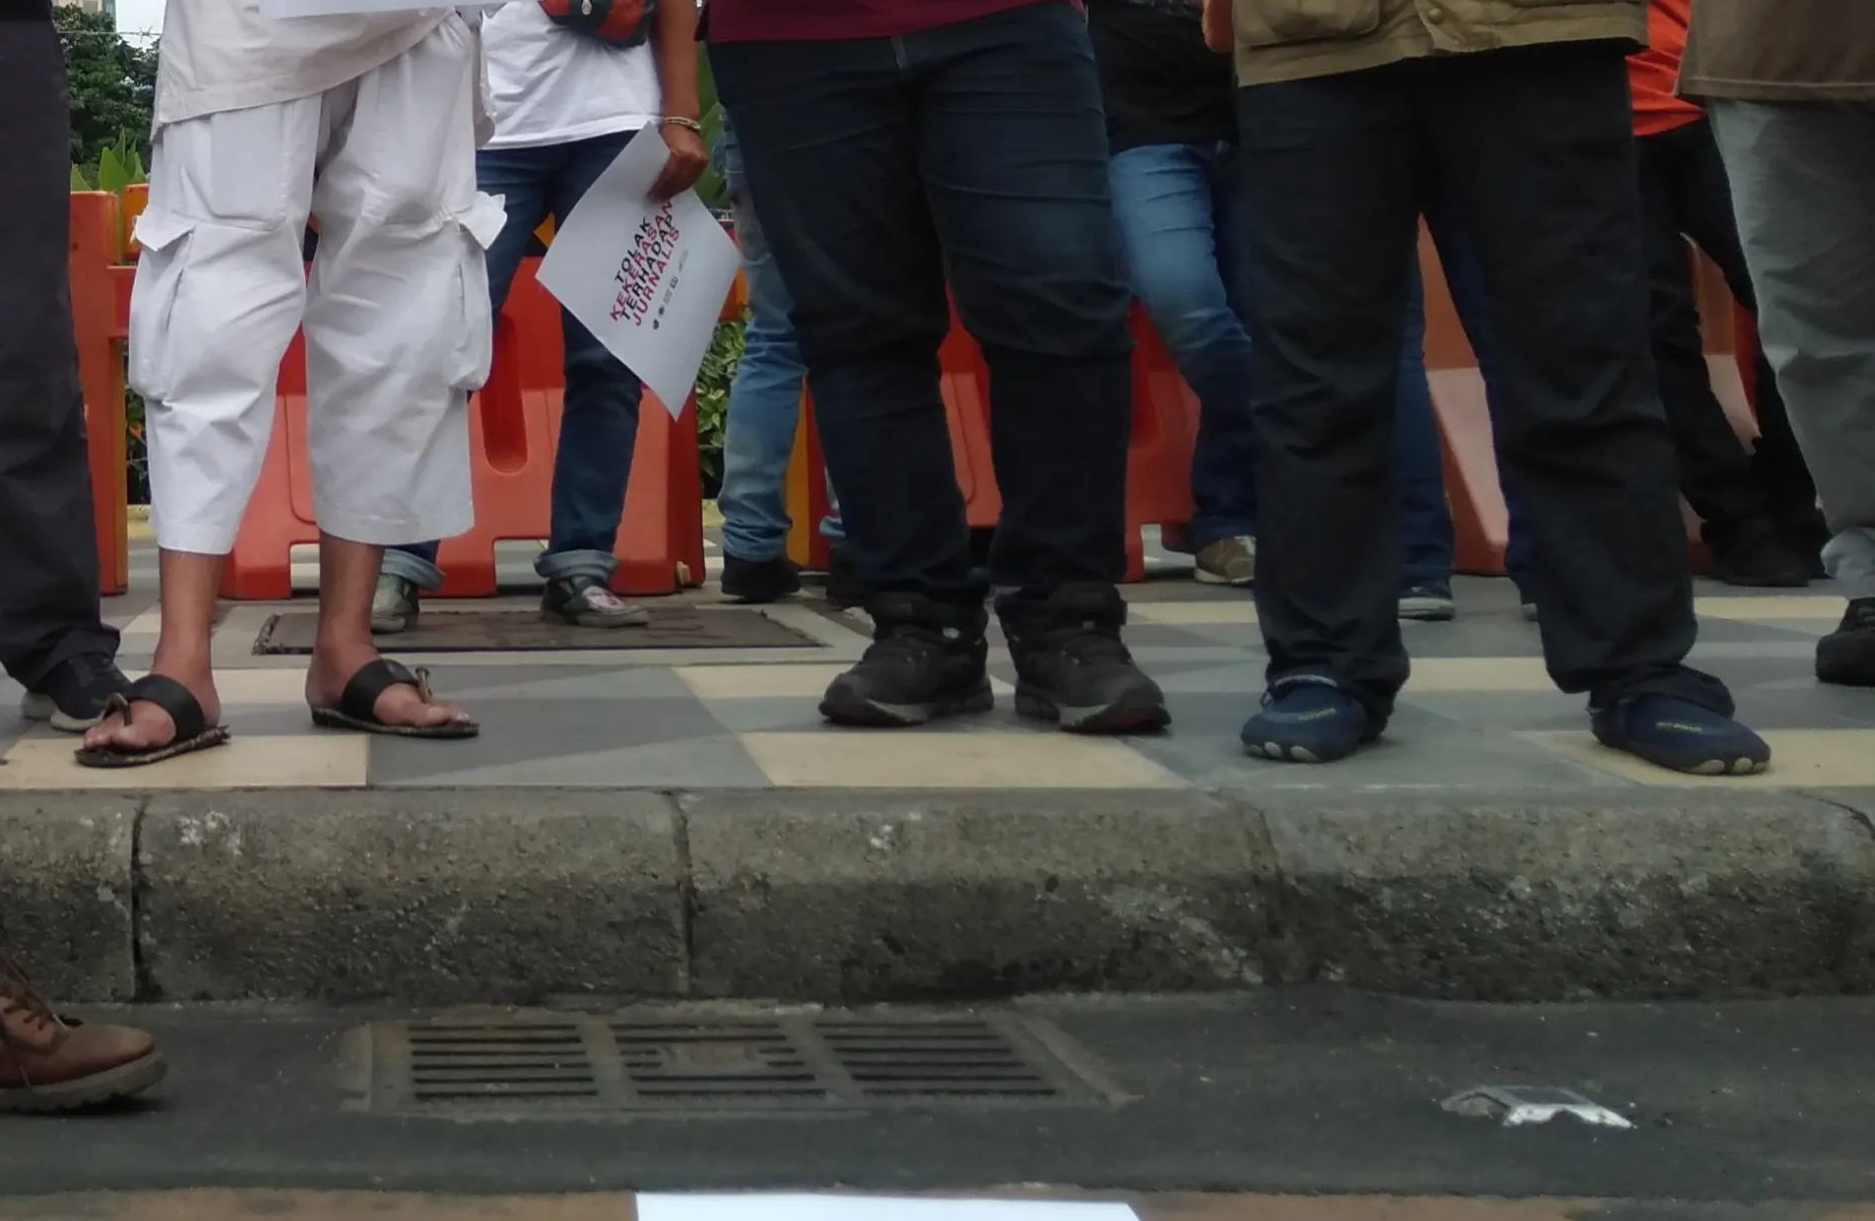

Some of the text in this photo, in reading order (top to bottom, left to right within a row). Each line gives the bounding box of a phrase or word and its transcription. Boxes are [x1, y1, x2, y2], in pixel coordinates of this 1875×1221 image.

[610, 199, 674, 322] KEKERASAN
[614, 217, 651, 284] TOLAK
[620, 213, 673, 321] TERHADAP
[633, 226, 680, 327] JURNALIS
